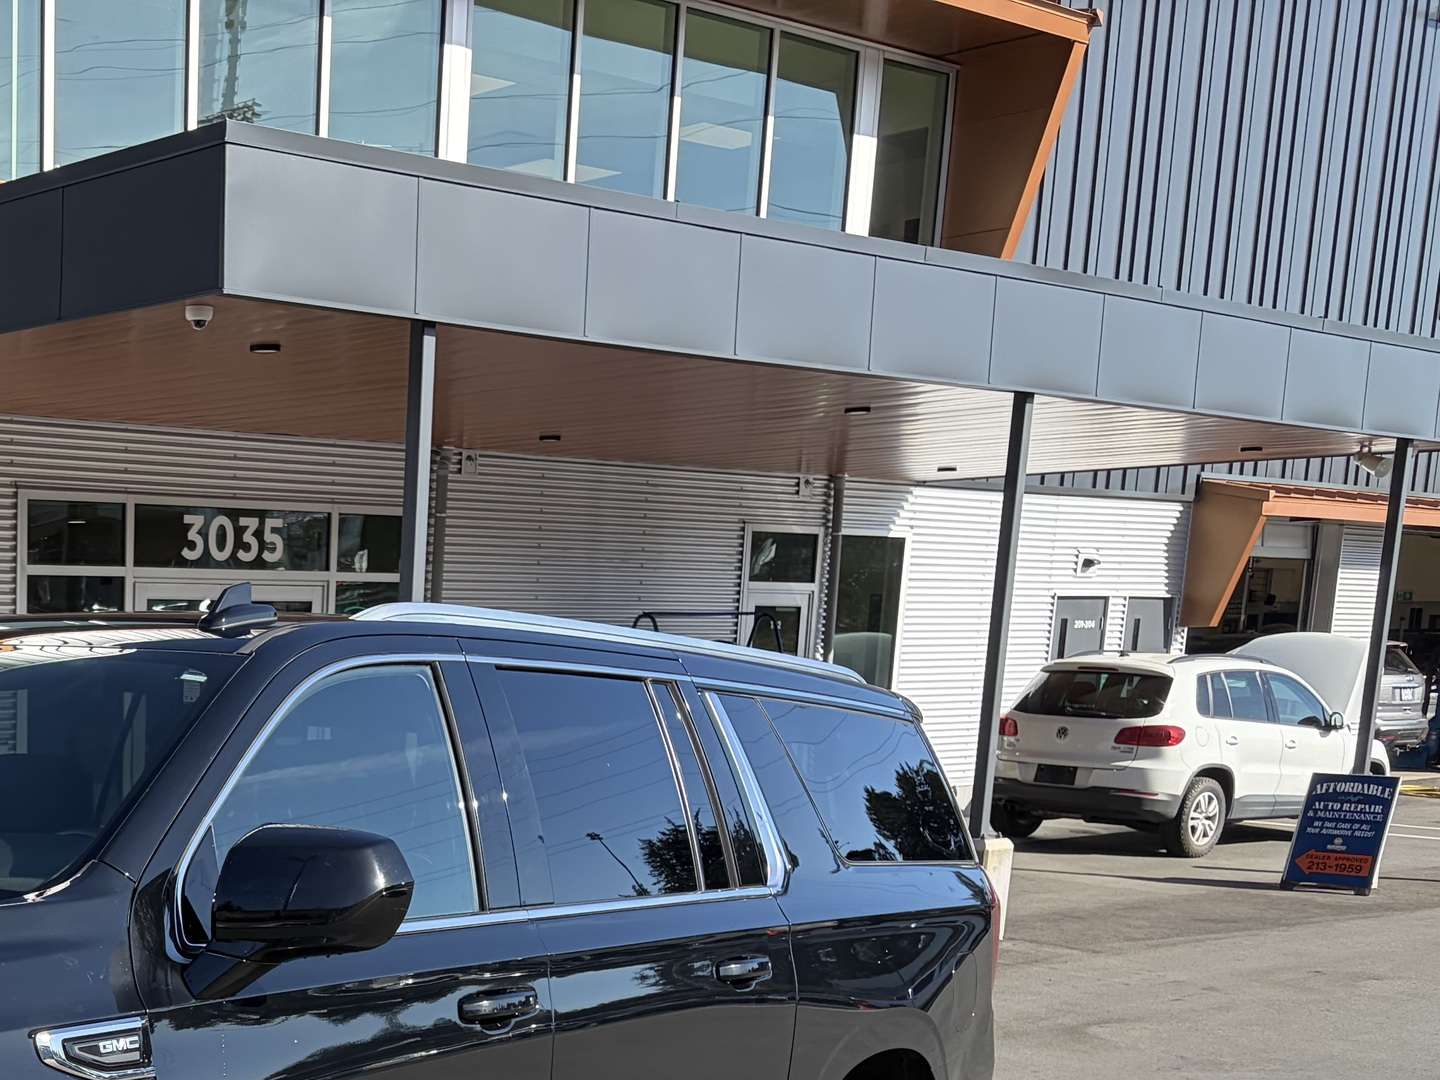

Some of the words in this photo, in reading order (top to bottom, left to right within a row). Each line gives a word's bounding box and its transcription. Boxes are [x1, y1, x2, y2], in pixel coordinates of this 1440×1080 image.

[181, 514, 284, 562] 3035
[1312, 782, 1393, 799] AFFORDABLE
[1312, 802, 1341, 811] AUTO
[1342, 803, 1383, 813] REPAIR
[1316, 810, 1384, 822] MAINTENANCE
[1334, 855, 1370, 864] APPROVED
[1306, 861, 1362, 873] 213-1959
[99, 1035, 140, 1053] GMC
